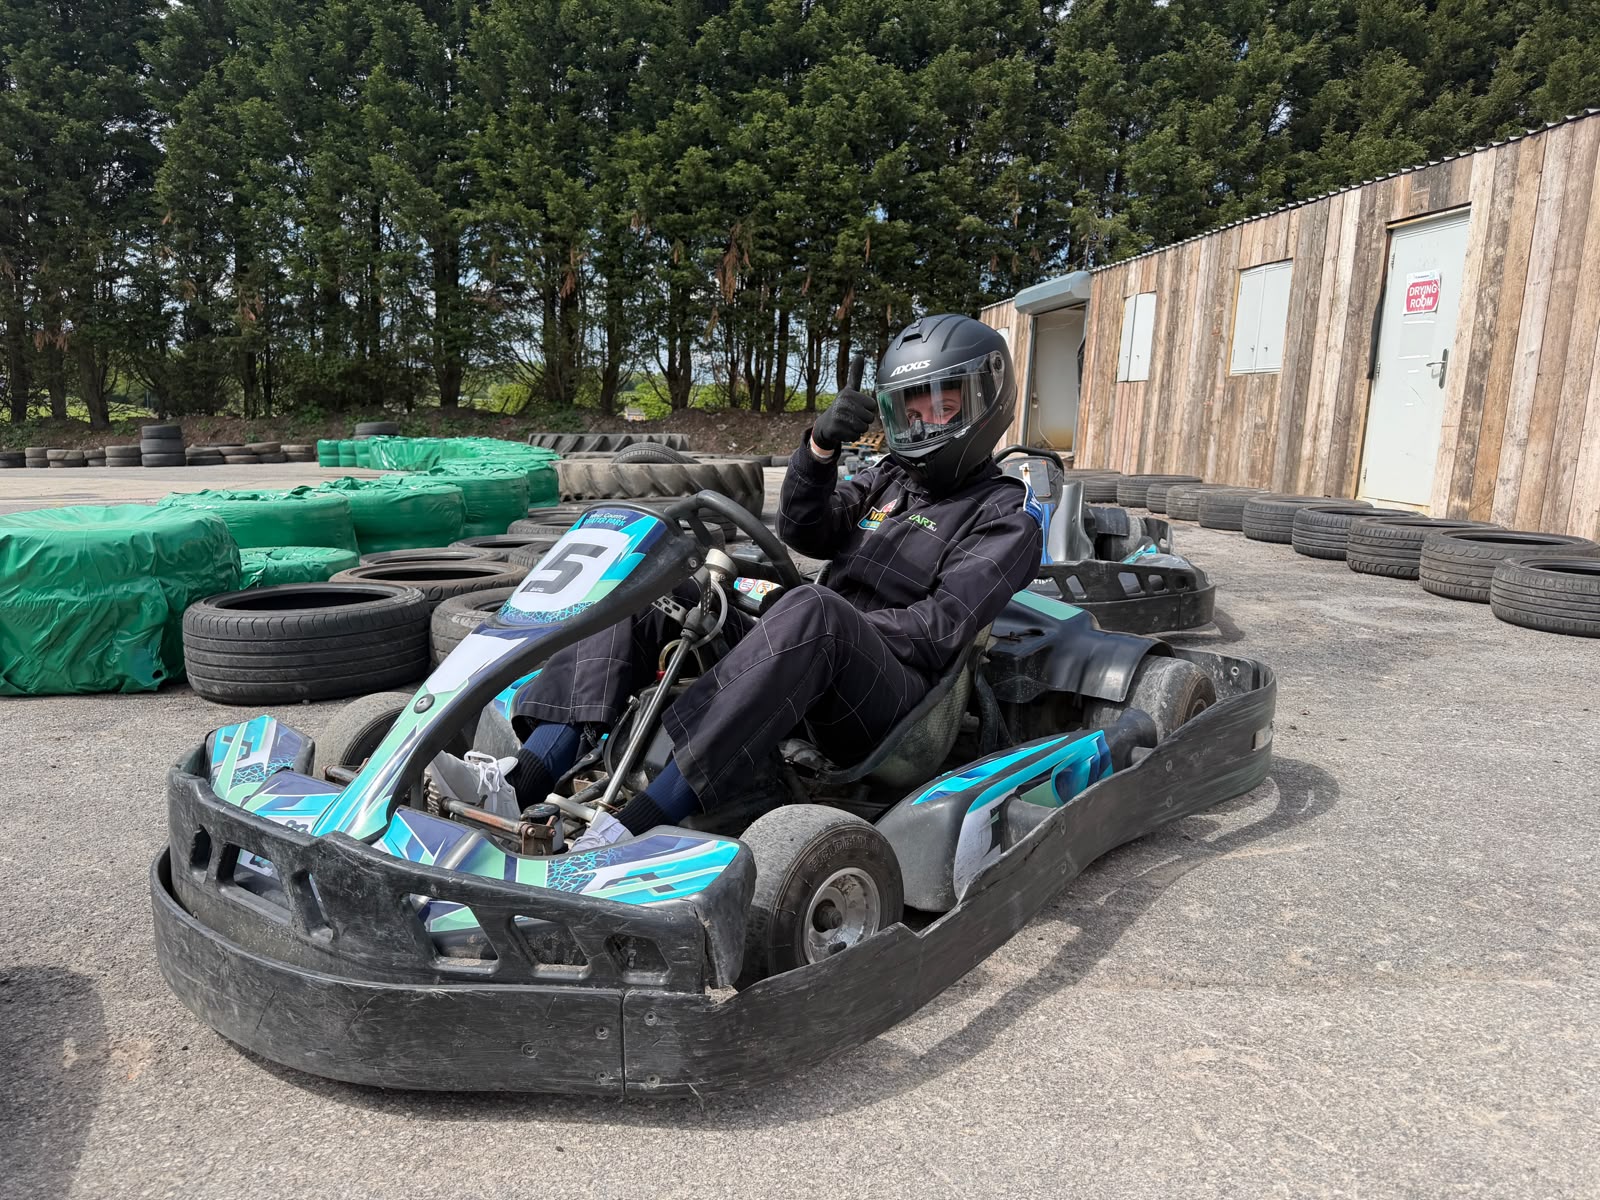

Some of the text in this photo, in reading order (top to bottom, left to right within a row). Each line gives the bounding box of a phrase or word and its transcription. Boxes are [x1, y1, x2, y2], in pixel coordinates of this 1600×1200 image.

[1409, 284, 1437, 297] DRYING
[1410, 297, 1433, 308] ROOM
[889, 359, 932, 378] AXXIS
[604, 513, 628, 521] Country
[605, 518, 626, 527] PARK
[519, 542, 609, 595] 5
